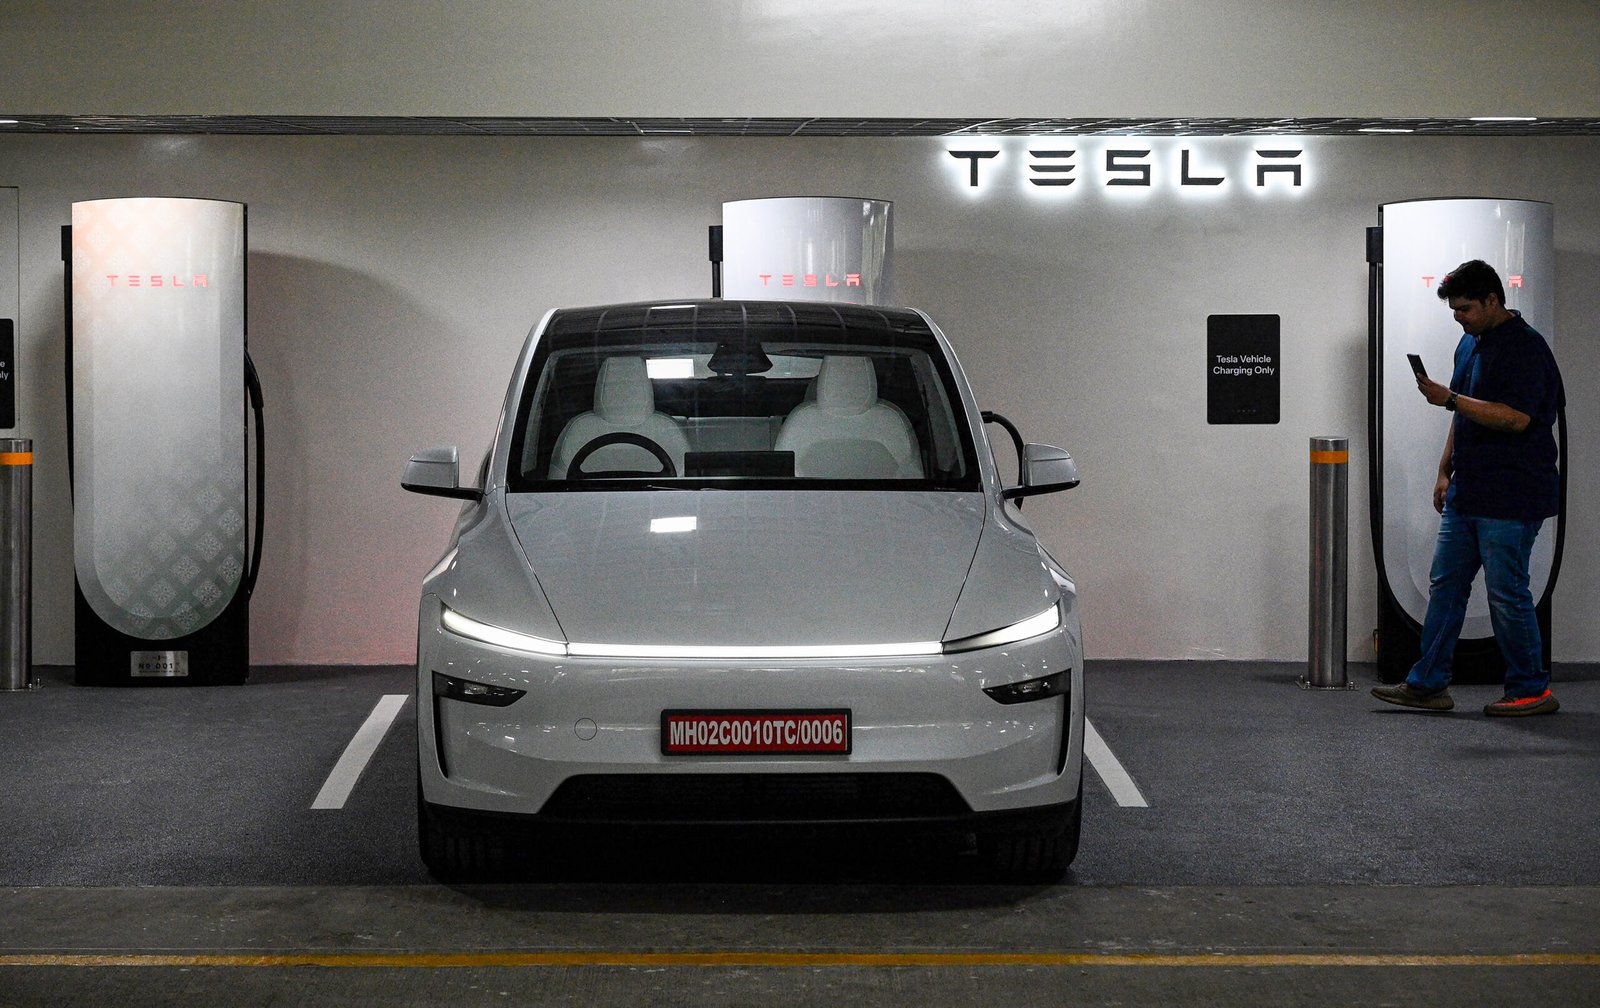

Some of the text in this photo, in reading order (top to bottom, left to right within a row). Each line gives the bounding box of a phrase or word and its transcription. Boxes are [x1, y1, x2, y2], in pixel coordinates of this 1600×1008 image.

[948, 149, 1303, 187] TESLA
[106, 275, 208, 287] TESLA
[759, 274, 861, 287] TESLA
[1216, 355, 1271, 363] Tesla Vehicle
[1213, 366, 1275, 376] Charging Only
[669, 720, 843, 745] MH02C0010TC/0006
